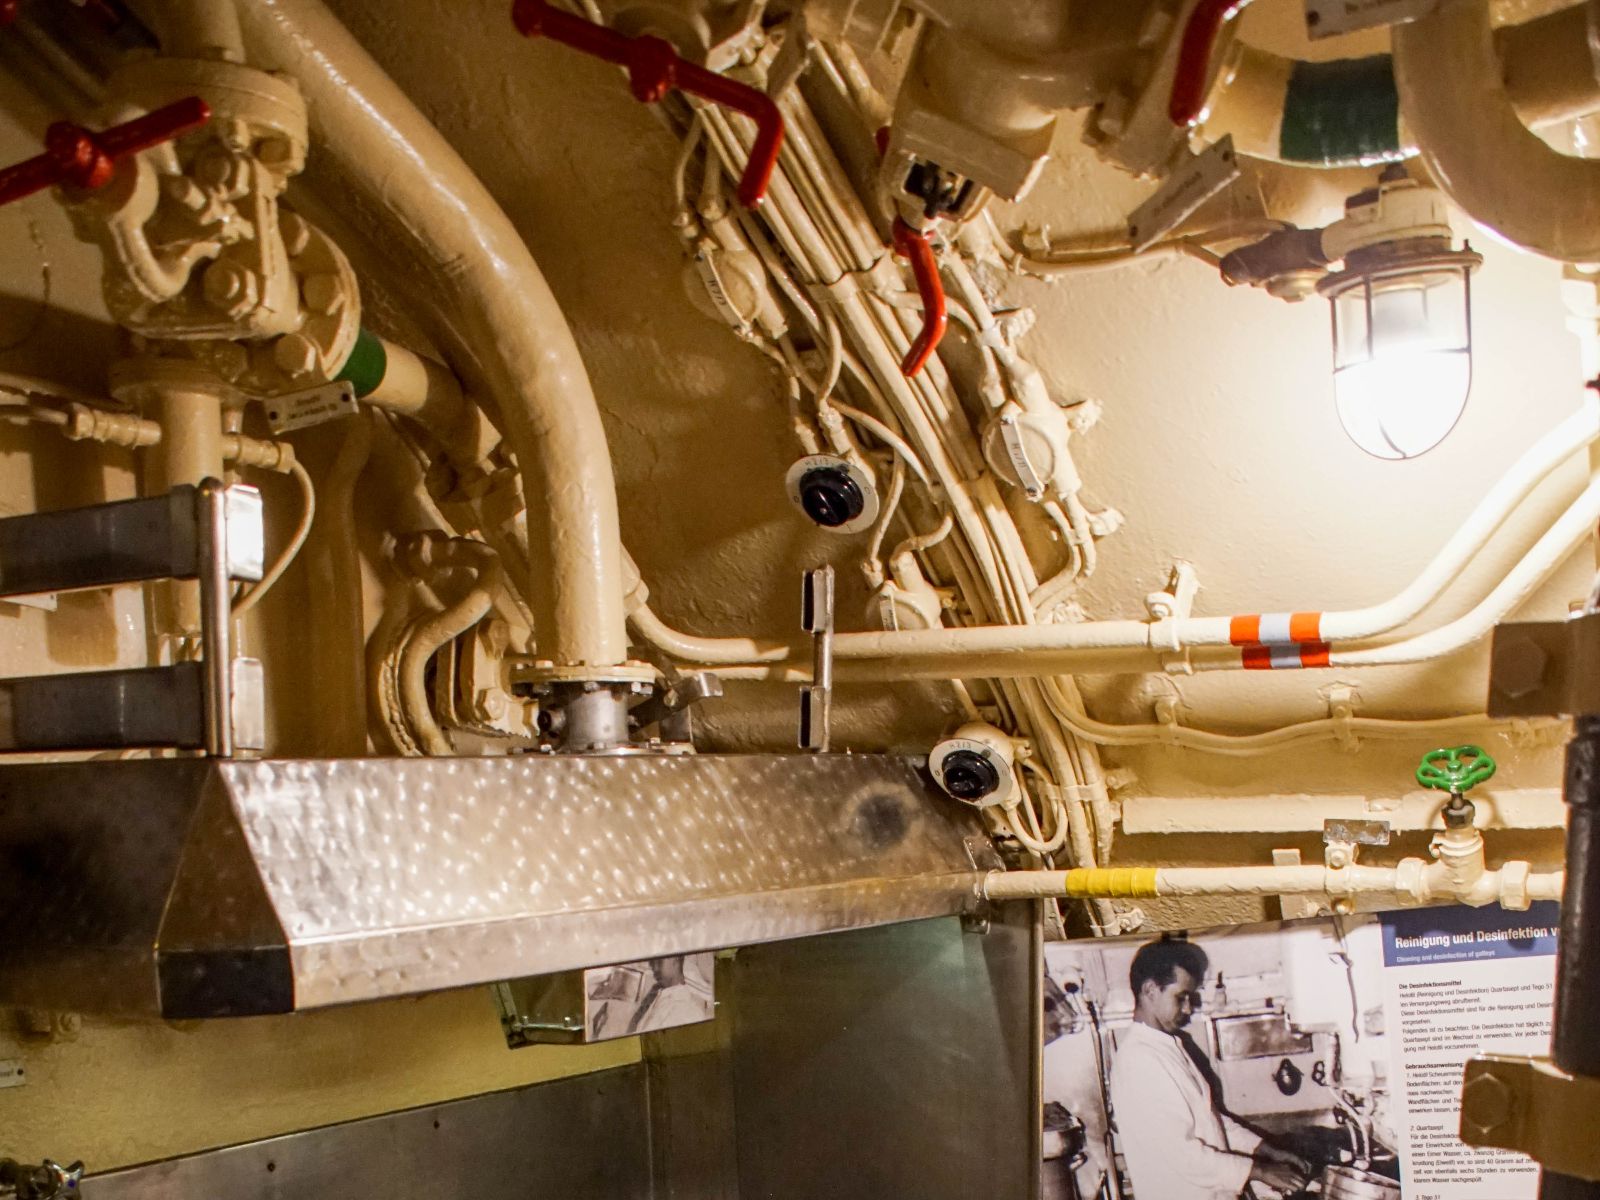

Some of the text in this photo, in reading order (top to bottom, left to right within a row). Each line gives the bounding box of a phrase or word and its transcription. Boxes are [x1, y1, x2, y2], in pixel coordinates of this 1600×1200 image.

[1395, 936, 1450, 949] Reinigung
[1453, 932, 1474, 944] und
[1477, 927, 1548, 942] Desinfektion
[1409, 980, 1462, 989] Desinfektionsmittel
